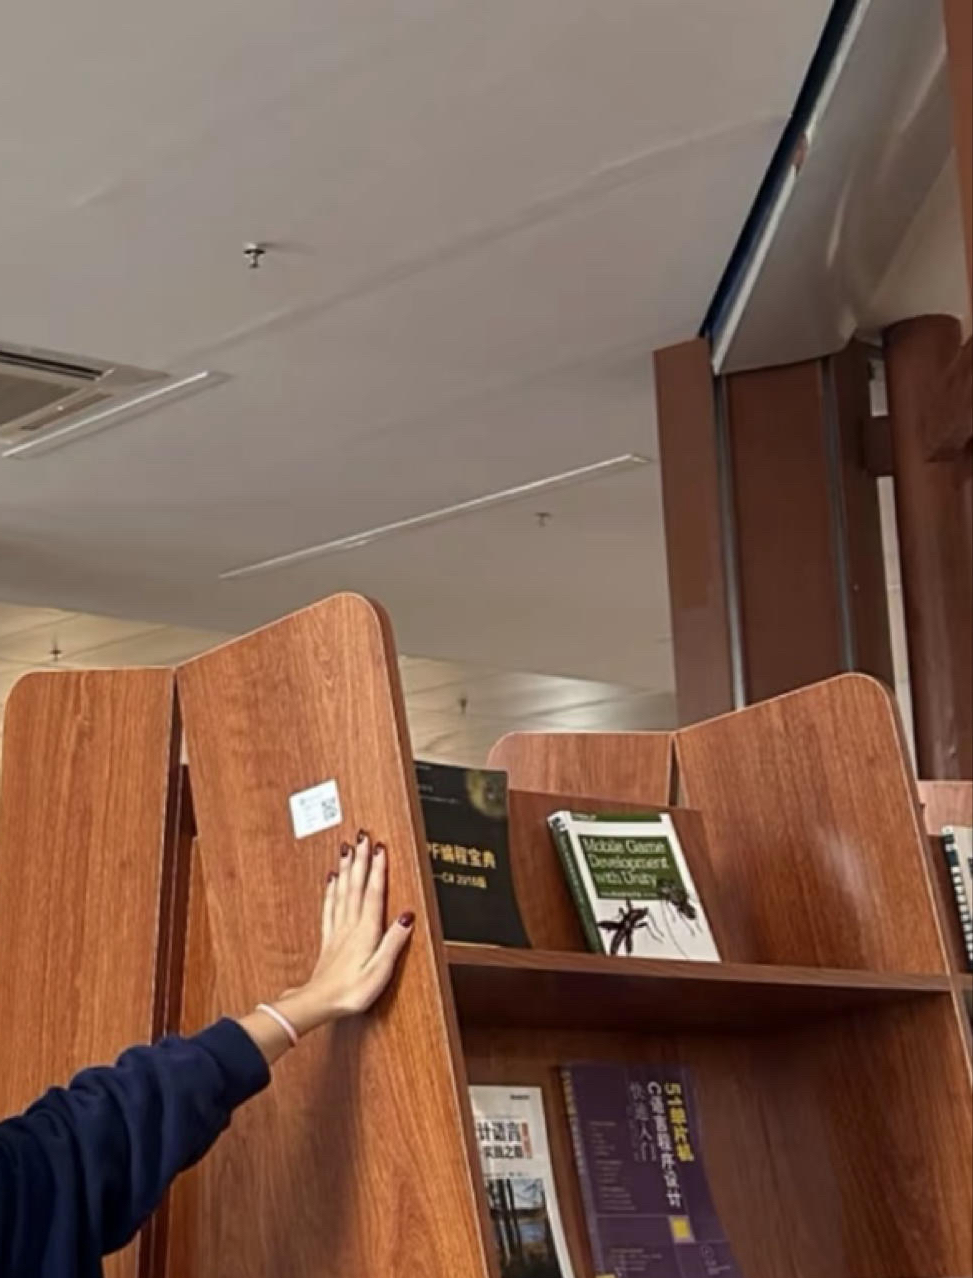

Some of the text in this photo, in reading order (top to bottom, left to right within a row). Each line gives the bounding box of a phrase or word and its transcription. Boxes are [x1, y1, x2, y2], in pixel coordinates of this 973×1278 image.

[583, 838, 666, 854] Mobile Game
[588, 853, 670, 872] Development
[594, 870, 657, 888] with Unity
